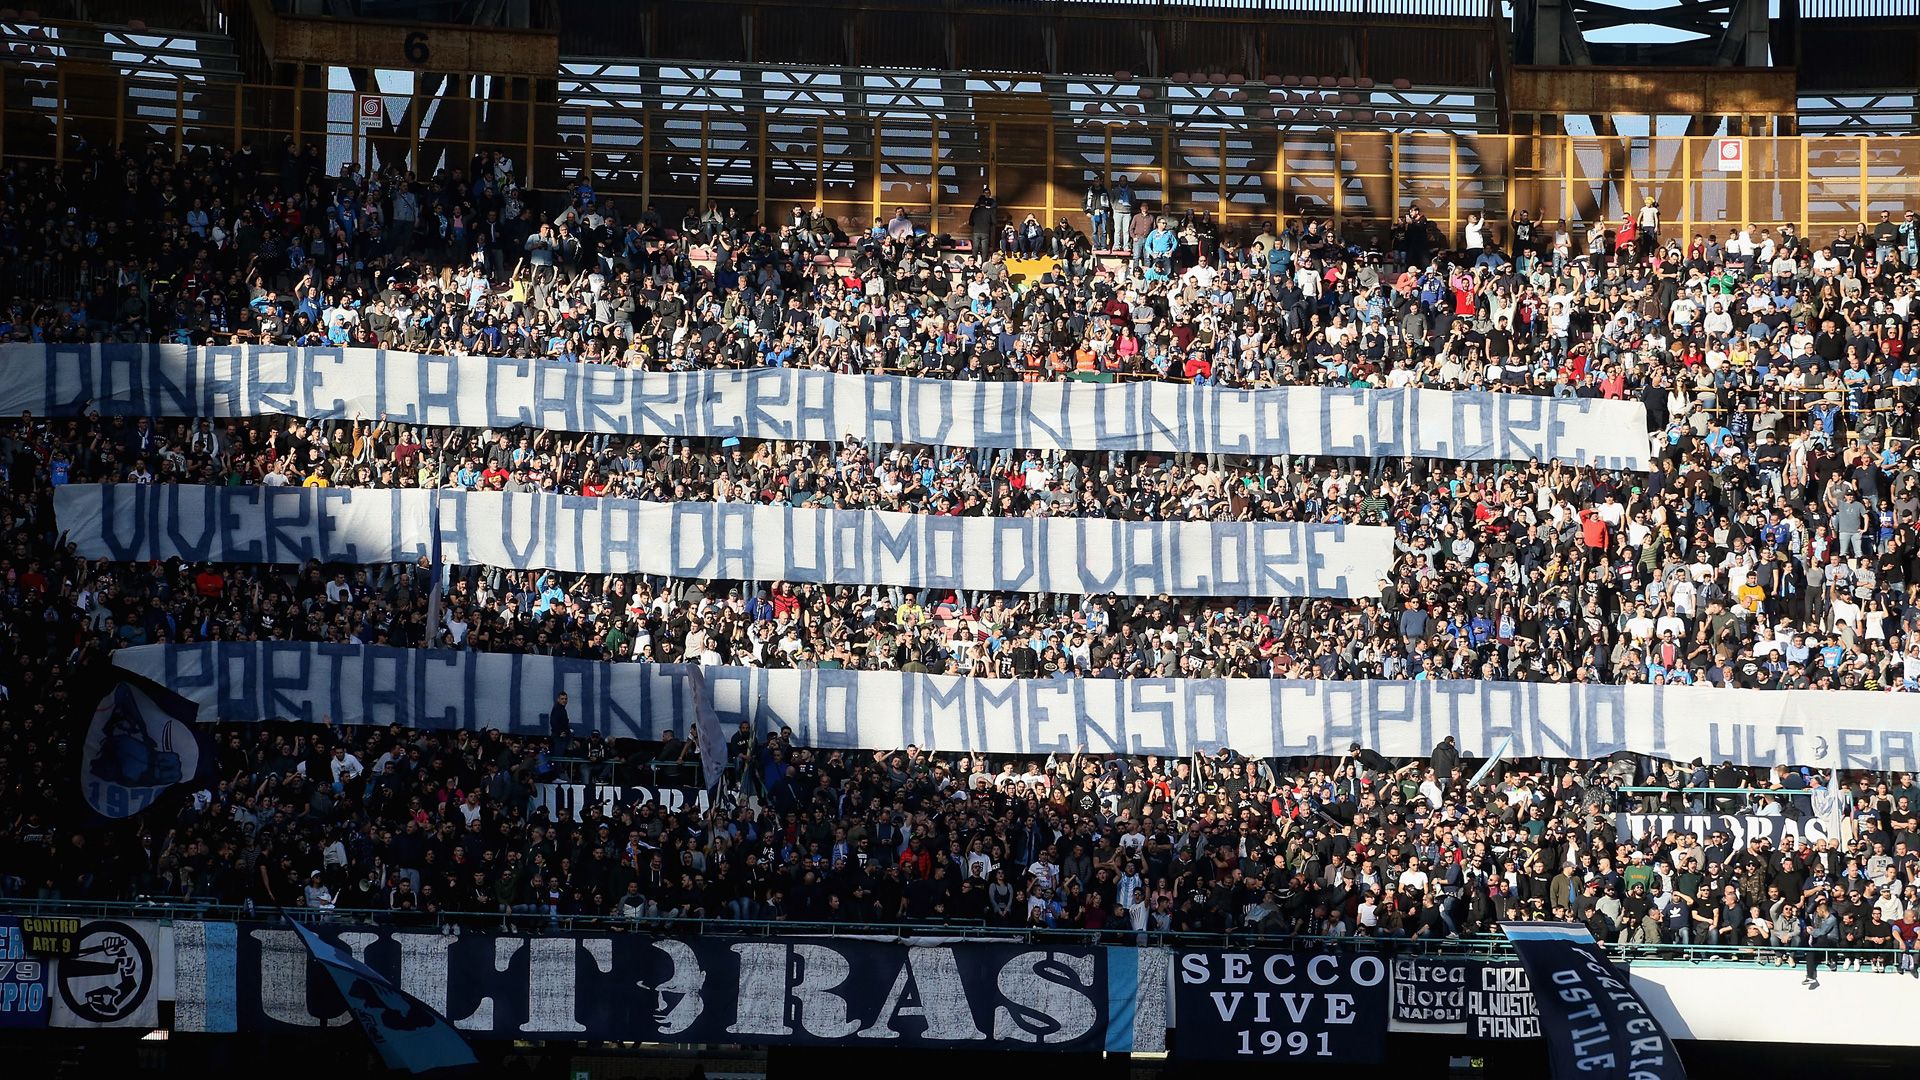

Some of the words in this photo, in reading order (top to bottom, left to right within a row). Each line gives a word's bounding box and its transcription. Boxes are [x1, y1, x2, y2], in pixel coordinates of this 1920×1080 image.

[404, 32, 429, 64] 6
[45, 343, 346, 419] DONARE
[376, 348, 460, 427] LA
[486, 357, 838, 440] CARRIERA
[865, 374, 954, 445] AD
[973, 380, 1074, 449] UN
[1095, 381, 1292, 455] UNICO
[1320, 387, 1638, 471] COLORE...
[101, 484, 358, 565] VIVERE
[391, 488, 470, 566] LA
[501, 492, 639, 575] VITA
[671, 501, 755, 579] DA
[784, 506, 964, 591] UOMO
[992, 517, 1051, 594] DI
[1077, 519, 1349, 599] VALORE
[164, 641, 477, 730] PORTACI
[901, 671, 1227, 758] IMMENSO
[89, 781, 164, 817] 197
[24, 918, 78, 934] CONTRO
[62, 938, 71, 953] 9
[1181, 953, 1385, 986] SECCO
[1395, 959, 1466, 983] Area
[1481, 968, 1530, 992] CIRO
[0, 983, 44, 1012] PIO
[1210, 991, 1356, 1024] VIVE
[1396, 983, 1465, 1006] Nord
[1489, 992, 1540, 1016] NOSTR
[1399, 1007, 1460, 1020] NAPOLI
[1478, 1016, 1541, 1038] FIANCO
[1552, 969, 1616, 1071] OSTILE
[1237, 1030, 1332, 1056] 1991
